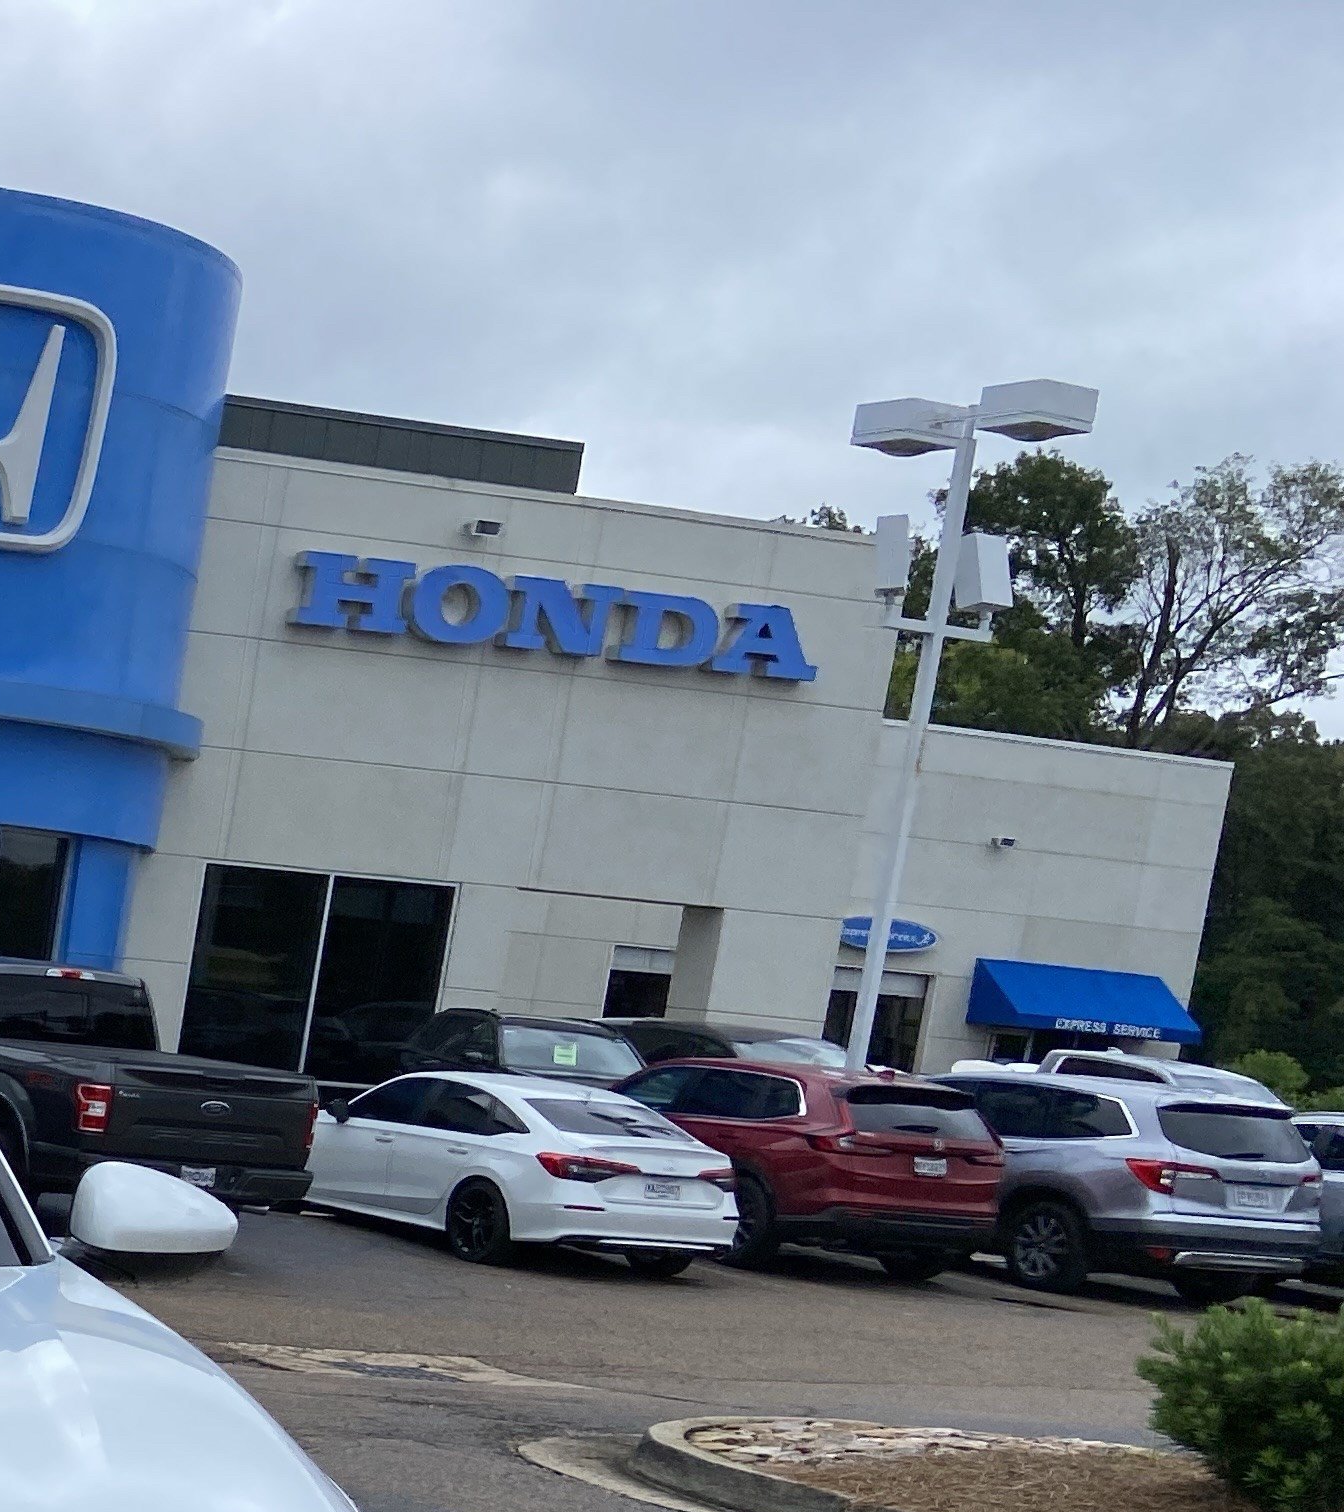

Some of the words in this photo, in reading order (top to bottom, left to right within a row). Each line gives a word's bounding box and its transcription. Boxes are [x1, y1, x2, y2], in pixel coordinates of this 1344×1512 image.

[287, 550, 818, 682] HONDA
[1055, 1017, 1108, 1035] EXPRESS
[1113, 1023, 1162, 1040] SERVICE
